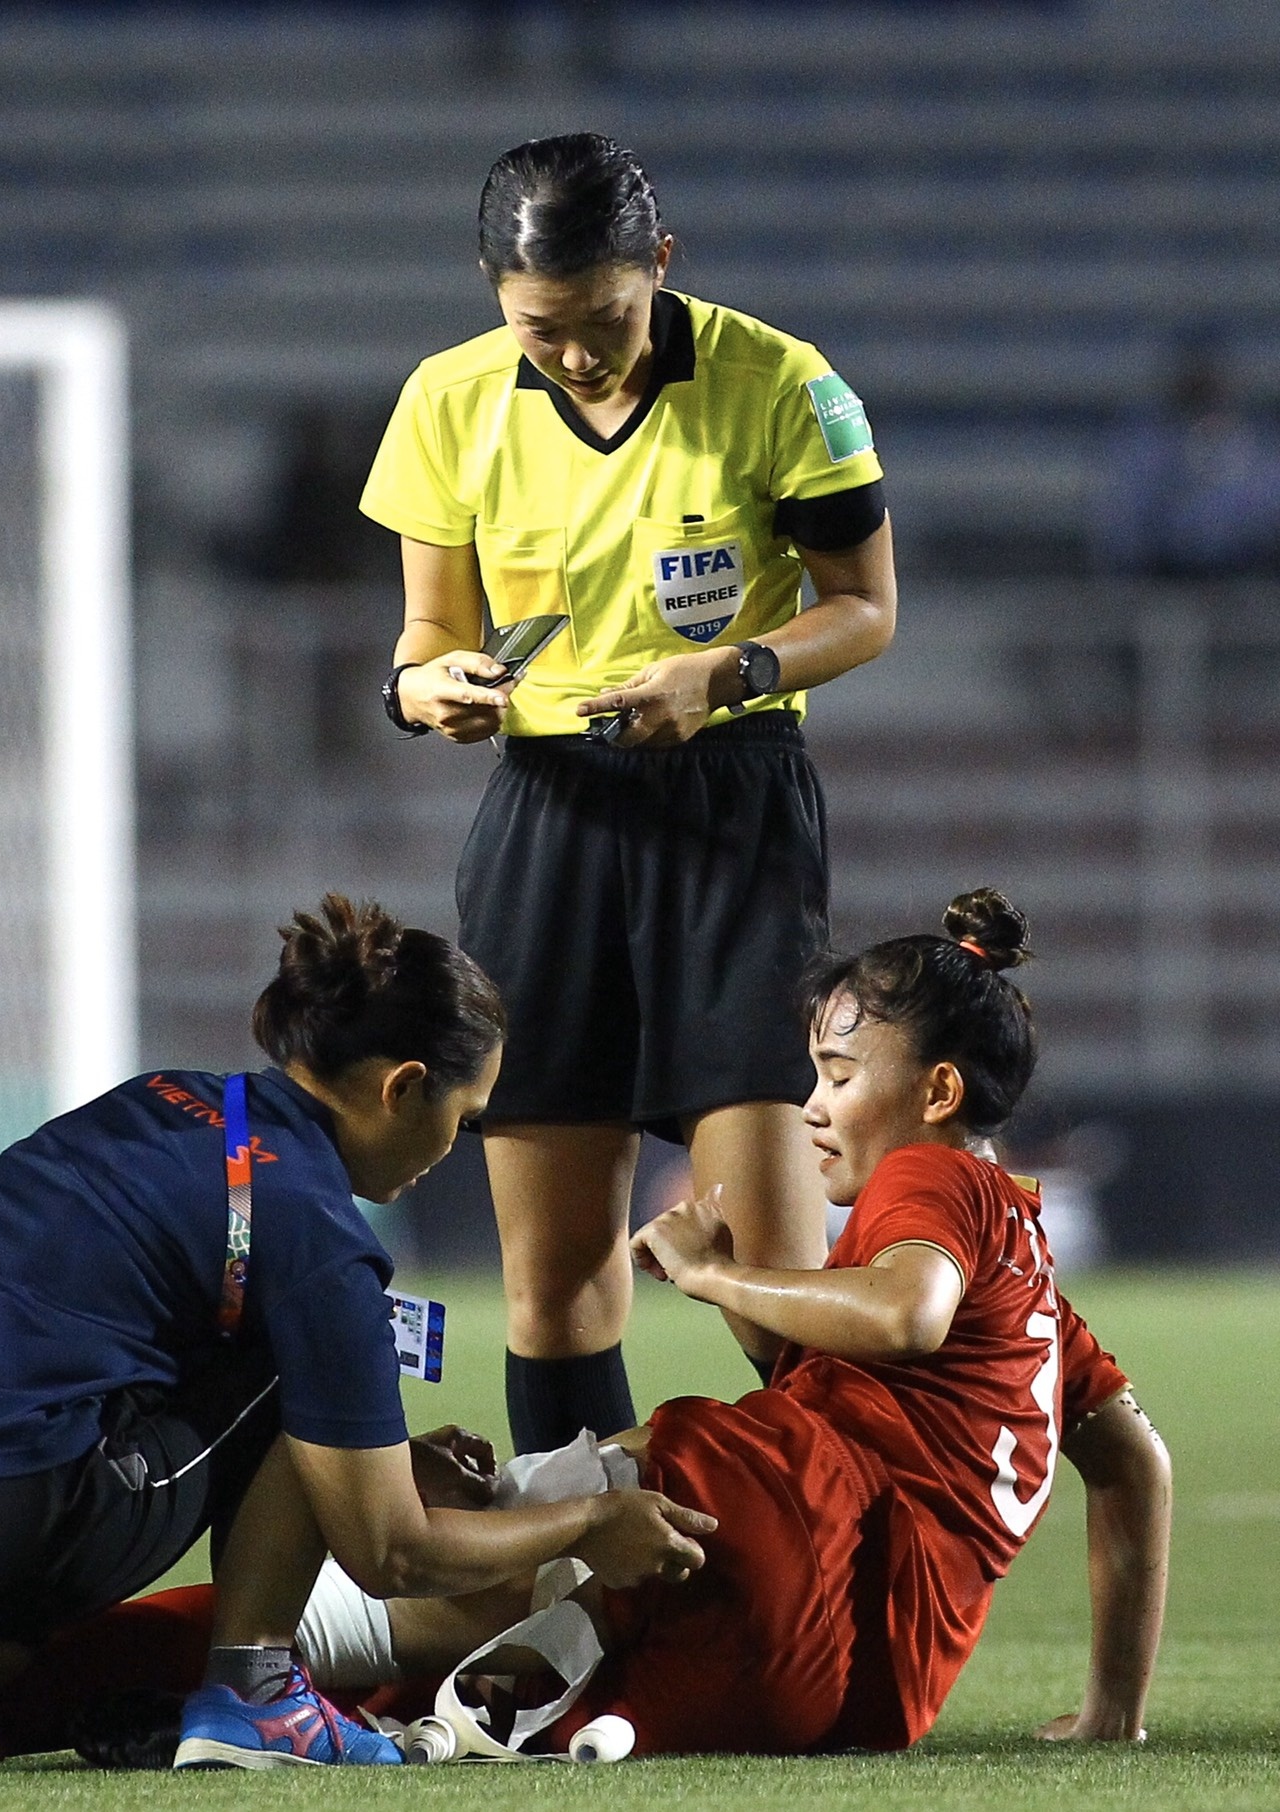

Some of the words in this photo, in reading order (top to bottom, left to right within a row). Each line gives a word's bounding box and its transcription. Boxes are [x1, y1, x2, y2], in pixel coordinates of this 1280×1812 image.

[660, 548, 735, 581] FIFA
[665, 585, 738, 611] REFEREE
[688, 620, 721, 637] 2019
[147, 1075, 279, 1163] VIETNM
